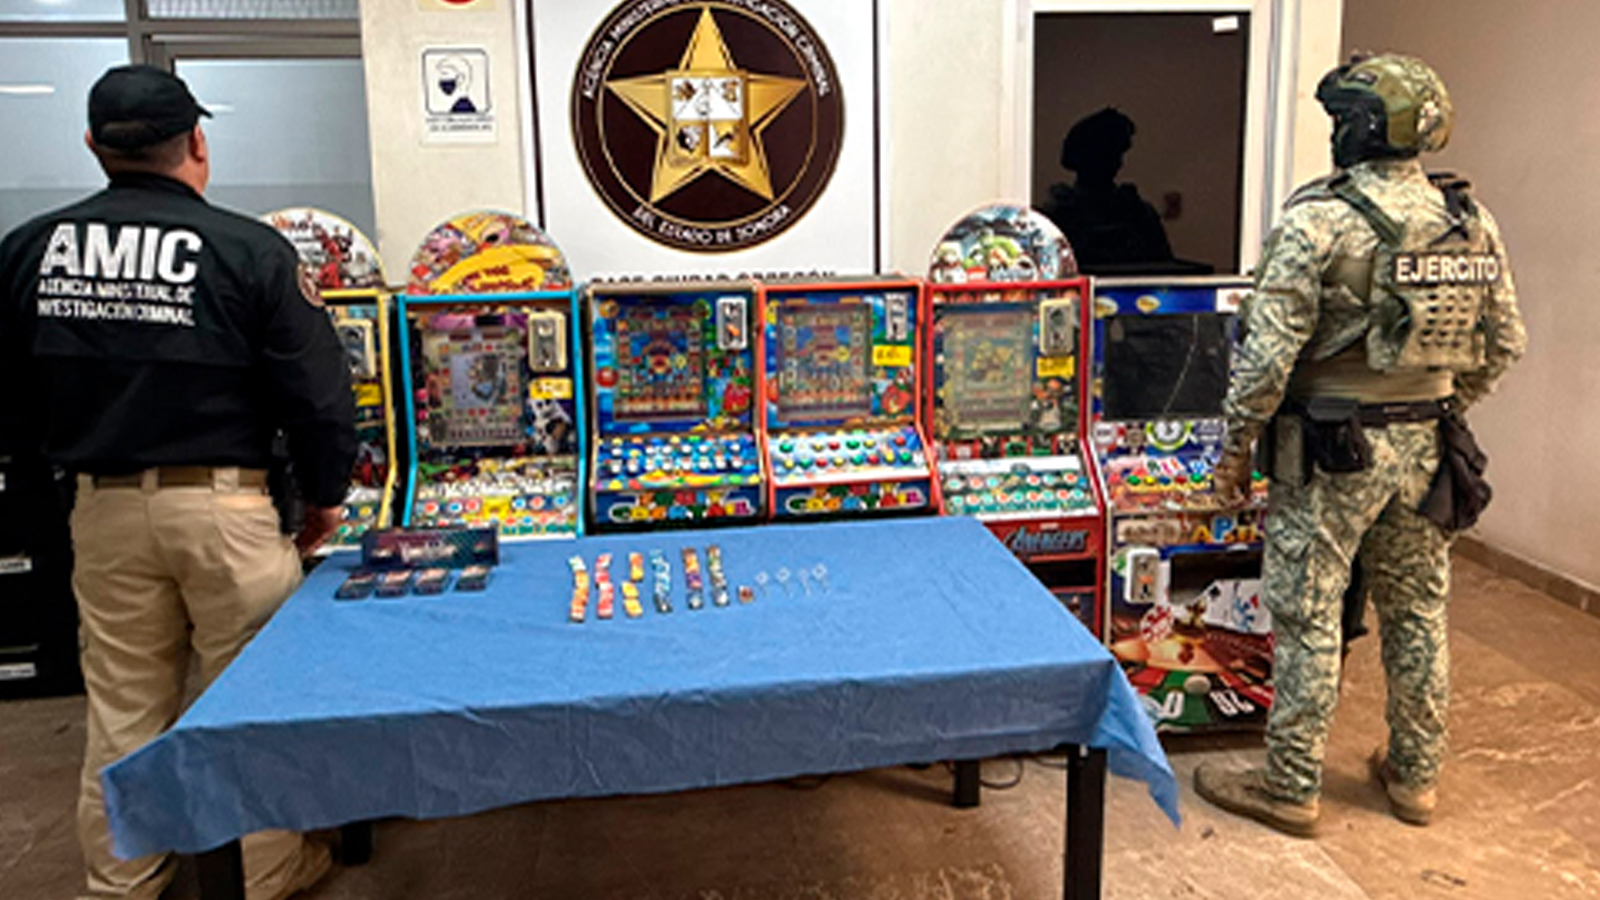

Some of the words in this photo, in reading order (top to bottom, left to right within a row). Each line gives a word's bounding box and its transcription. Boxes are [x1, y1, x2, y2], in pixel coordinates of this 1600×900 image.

[659, 221, 713, 244] ESTADO
[715, 227, 732, 243] DE
[736, 205, 792, 239] SONORA
[39, 222, 202, 284] AMIC
[1396, 255, 1499, 282] EJERCITO
[38, 277, 93, 297] AGENCIA
